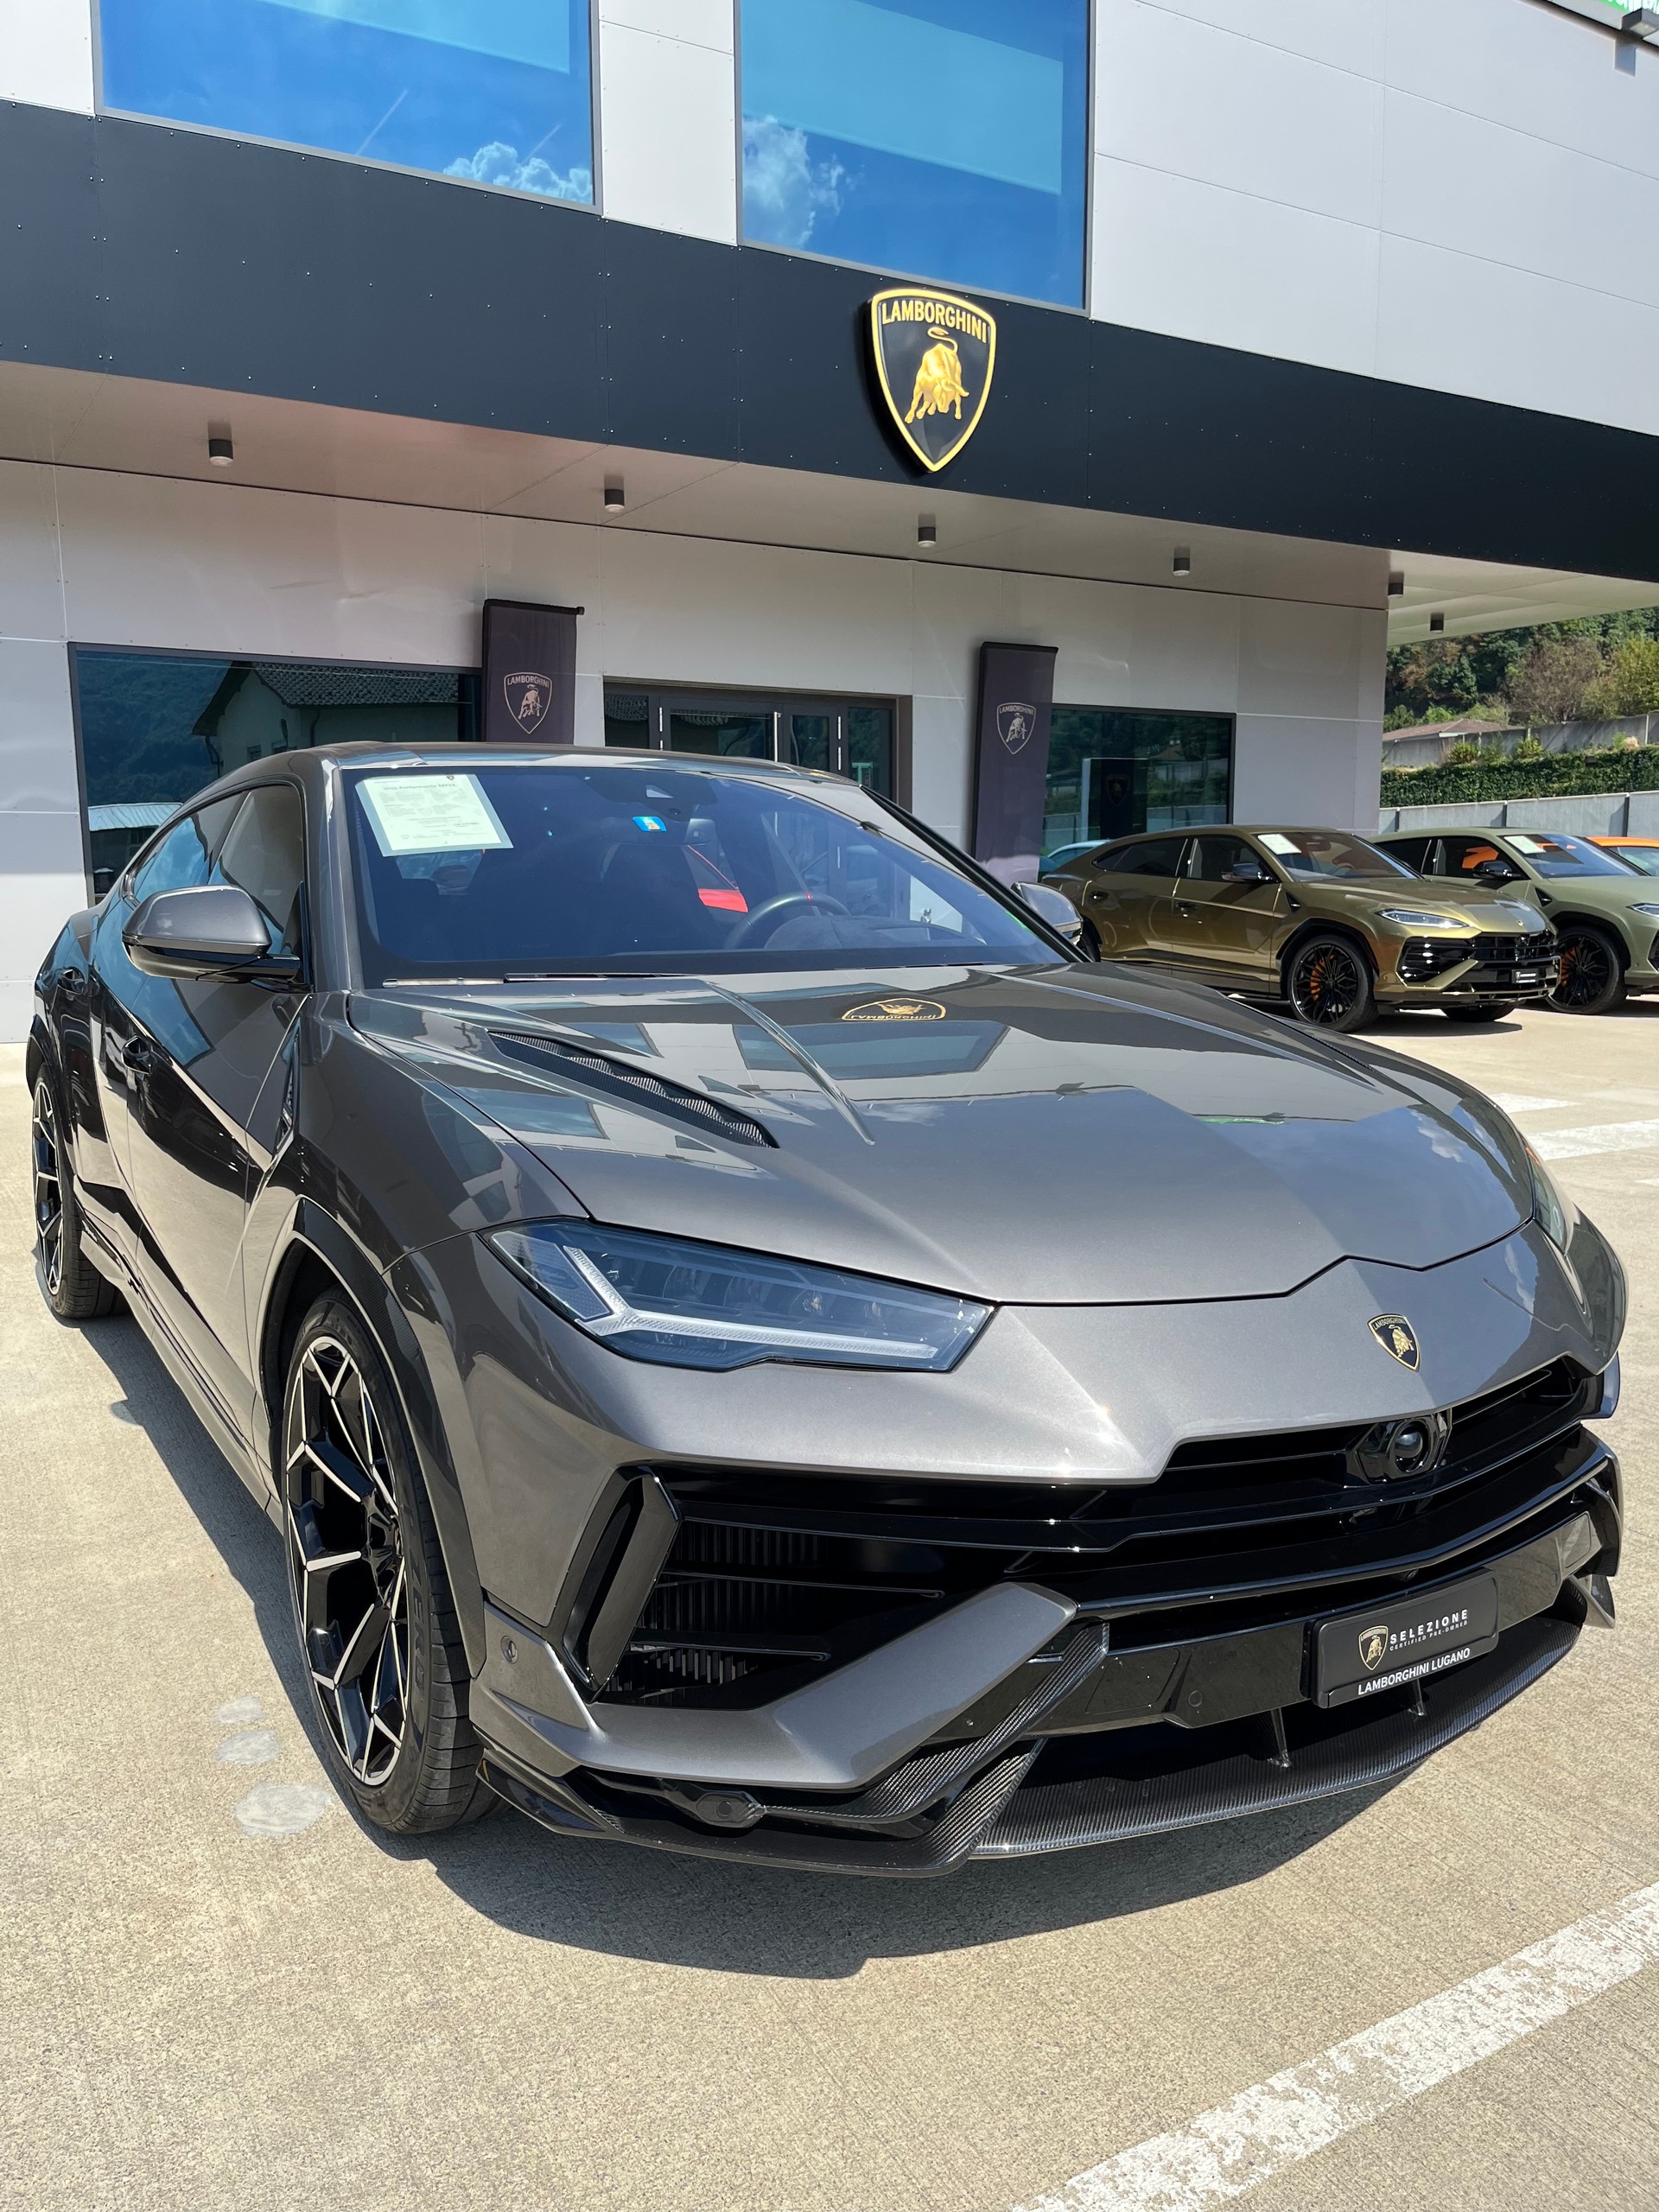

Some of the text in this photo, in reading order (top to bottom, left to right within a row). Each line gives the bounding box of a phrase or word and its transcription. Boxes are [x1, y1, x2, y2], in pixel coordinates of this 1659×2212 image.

[881, 300, 987, 343] LAMBORGHINI
[506, 675, 550, 689] LAMBORGHINI
[1389, 1609, 1468, 1644] SELEZIONE
[1389, 1620, 1468, 1651] CERTIFIED PRE-OWNED
[1358, 1648, 1471, 1695] LAMBORGHINI LUGANO
